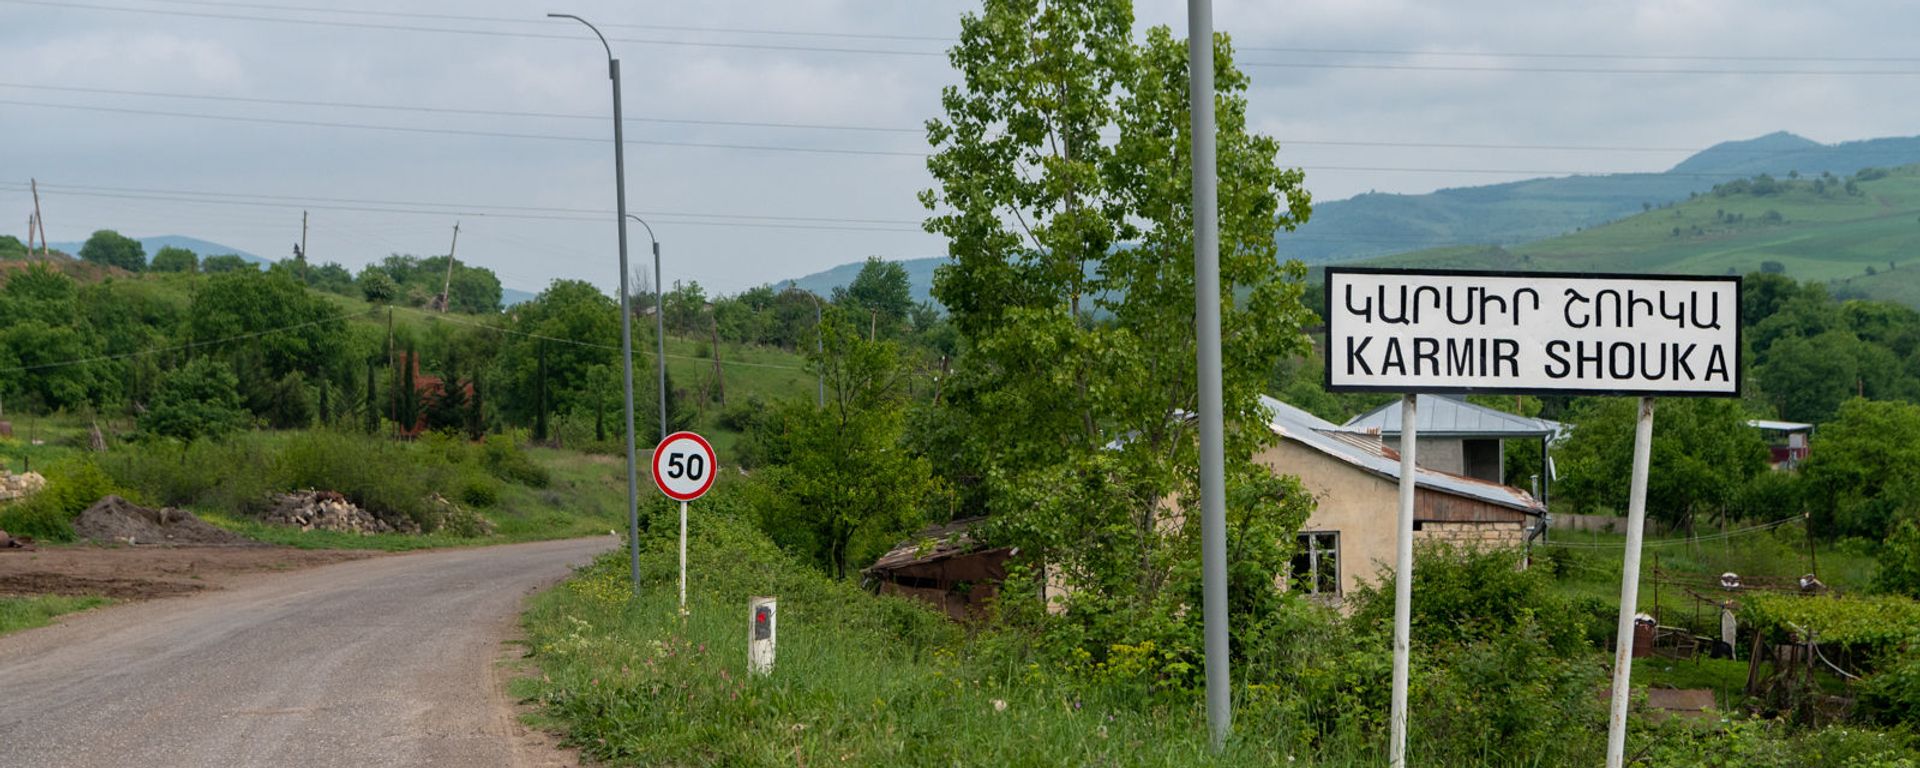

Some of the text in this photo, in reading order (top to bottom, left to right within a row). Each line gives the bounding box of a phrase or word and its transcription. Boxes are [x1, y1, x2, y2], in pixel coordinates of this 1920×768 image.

[1345, 283, 1540, 326] ԿԱՐՄԻՐ
[1346, 336, 1730, 383] KARMIR SHOUKA
[667, 452, 704, 481] 50
